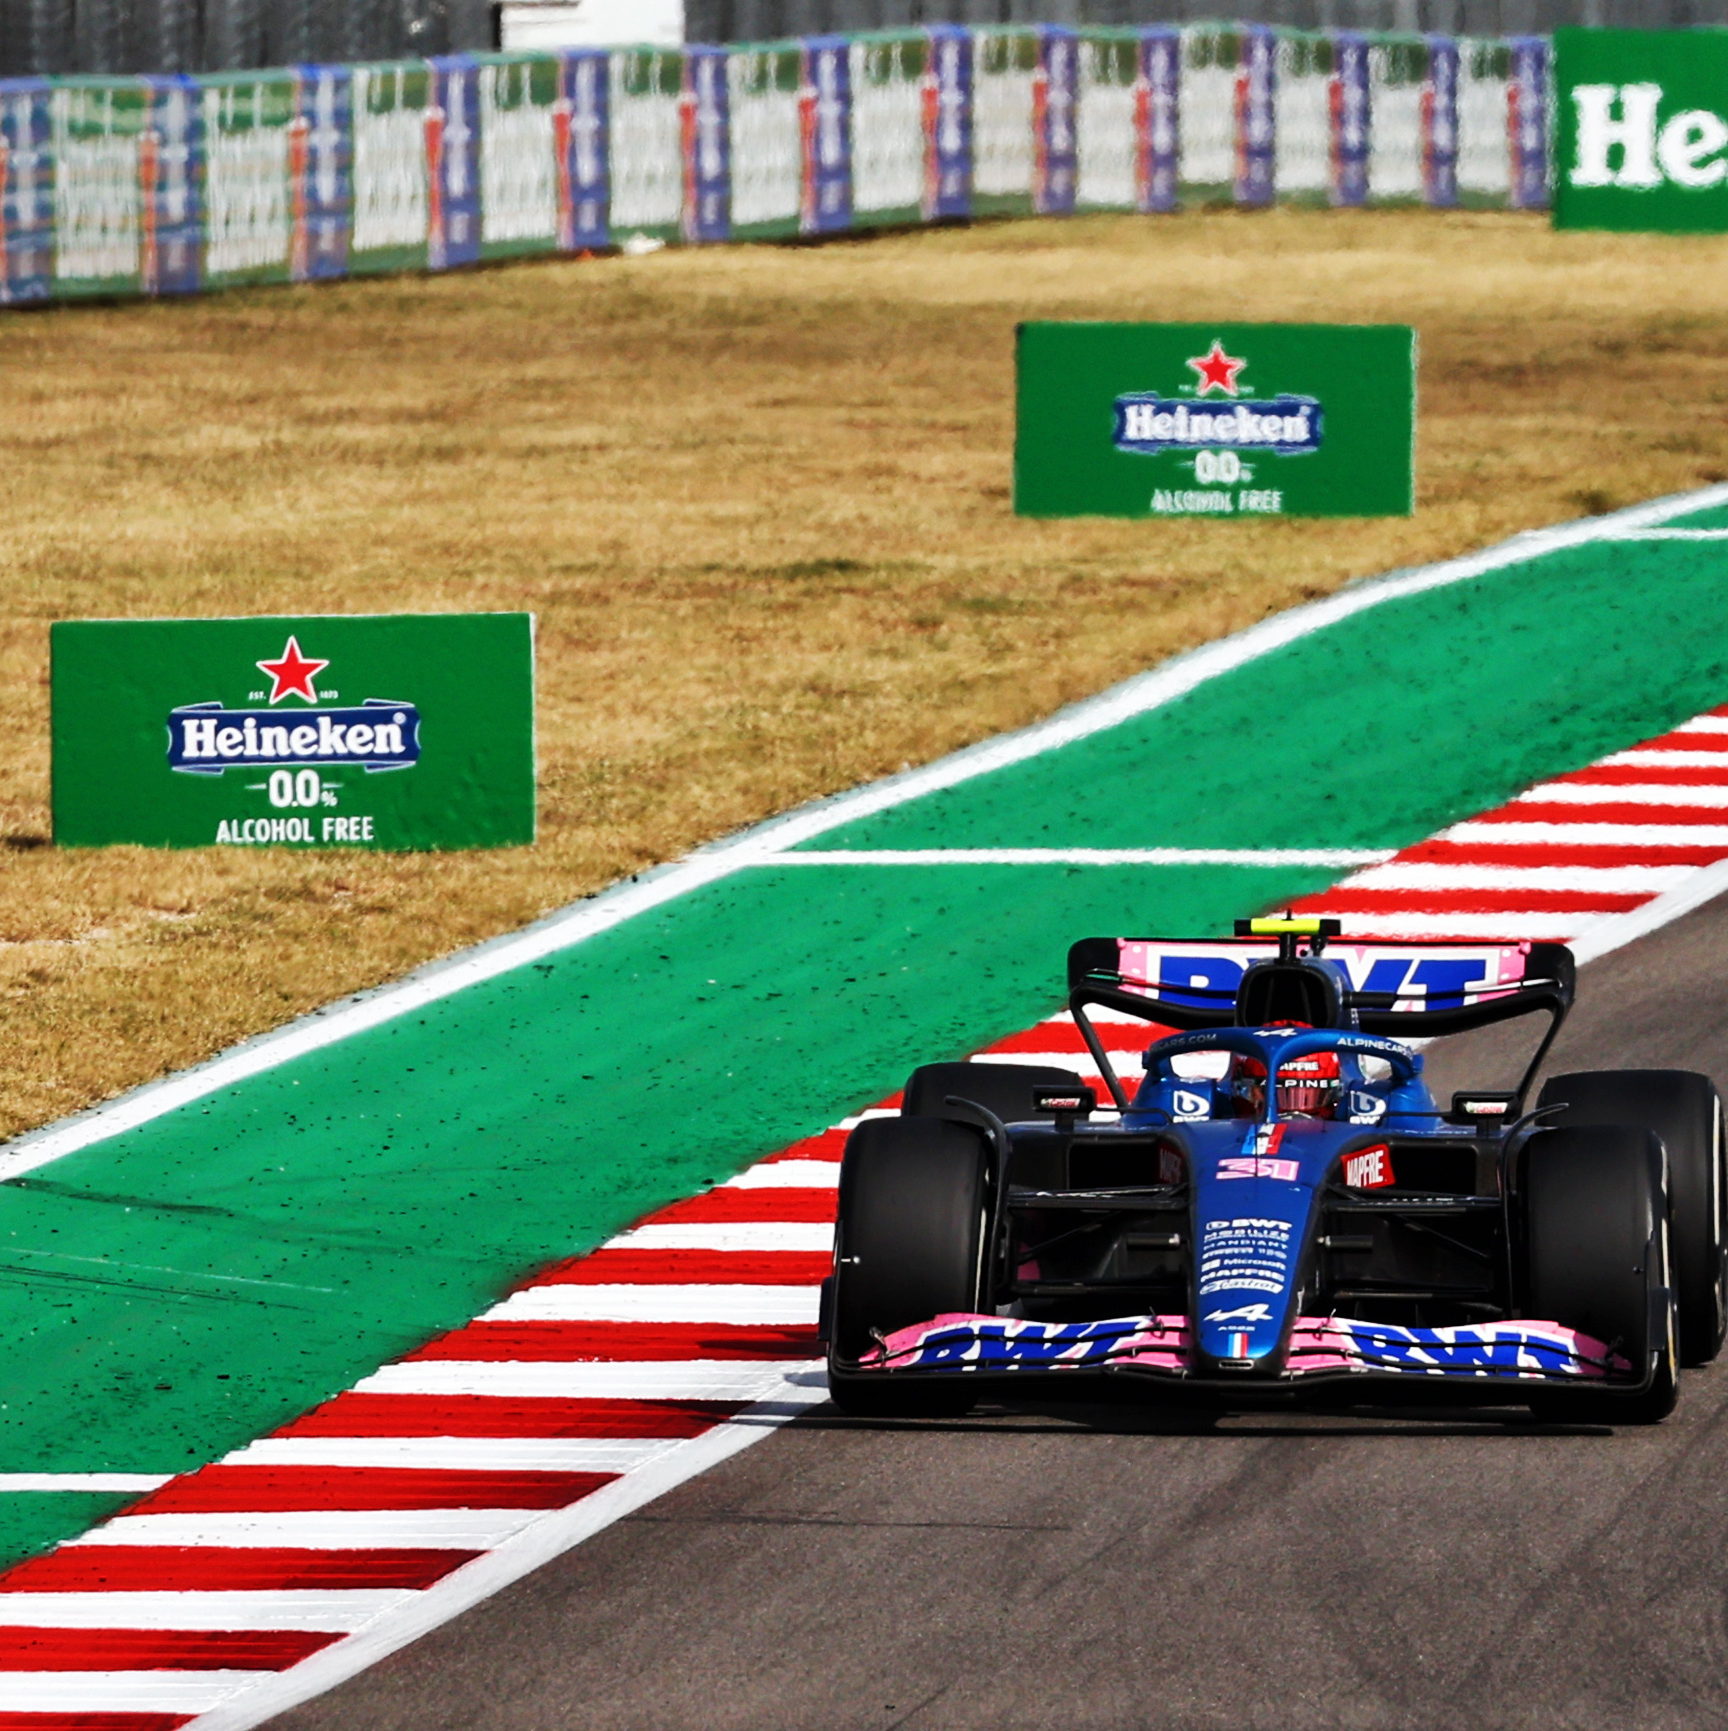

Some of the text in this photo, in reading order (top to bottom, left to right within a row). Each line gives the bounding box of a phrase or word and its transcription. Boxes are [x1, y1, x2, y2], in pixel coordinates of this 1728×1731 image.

[1125, 403, 1312, 443] Heineken
[182, 716, 405, 758] Heineken
[216, 816, 375, 843] ALCOHOL FREE
[1280, 1062, 1320, 1072] APFRE
[1216, 1157, 1300, 1181] 31
[1346, 1150, 1384, 1188] MAPFRE
[1232, 1218, 1293, 1230] BWT
